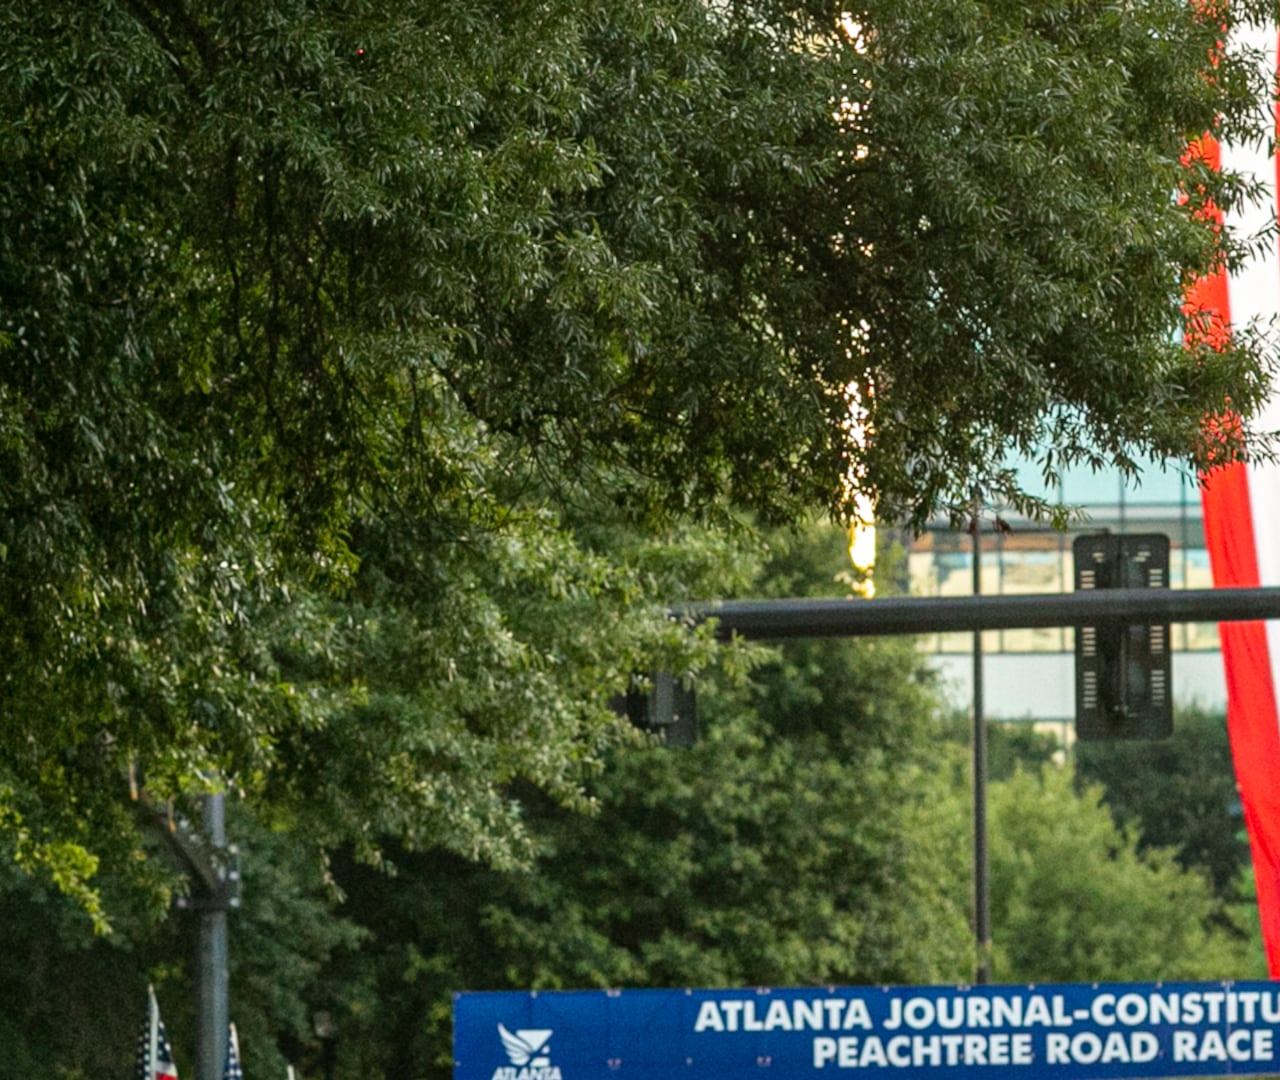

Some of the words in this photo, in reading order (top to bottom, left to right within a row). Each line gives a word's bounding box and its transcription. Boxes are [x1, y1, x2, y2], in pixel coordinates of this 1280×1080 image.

[694, 999, 873, 1033] ATLANTA
[813, 1033, 1032, 1068] PEACHTREE
[1046, 1031, 1158, 1064] ROAD
[1173, 1029, 1273, 1061] RACE
